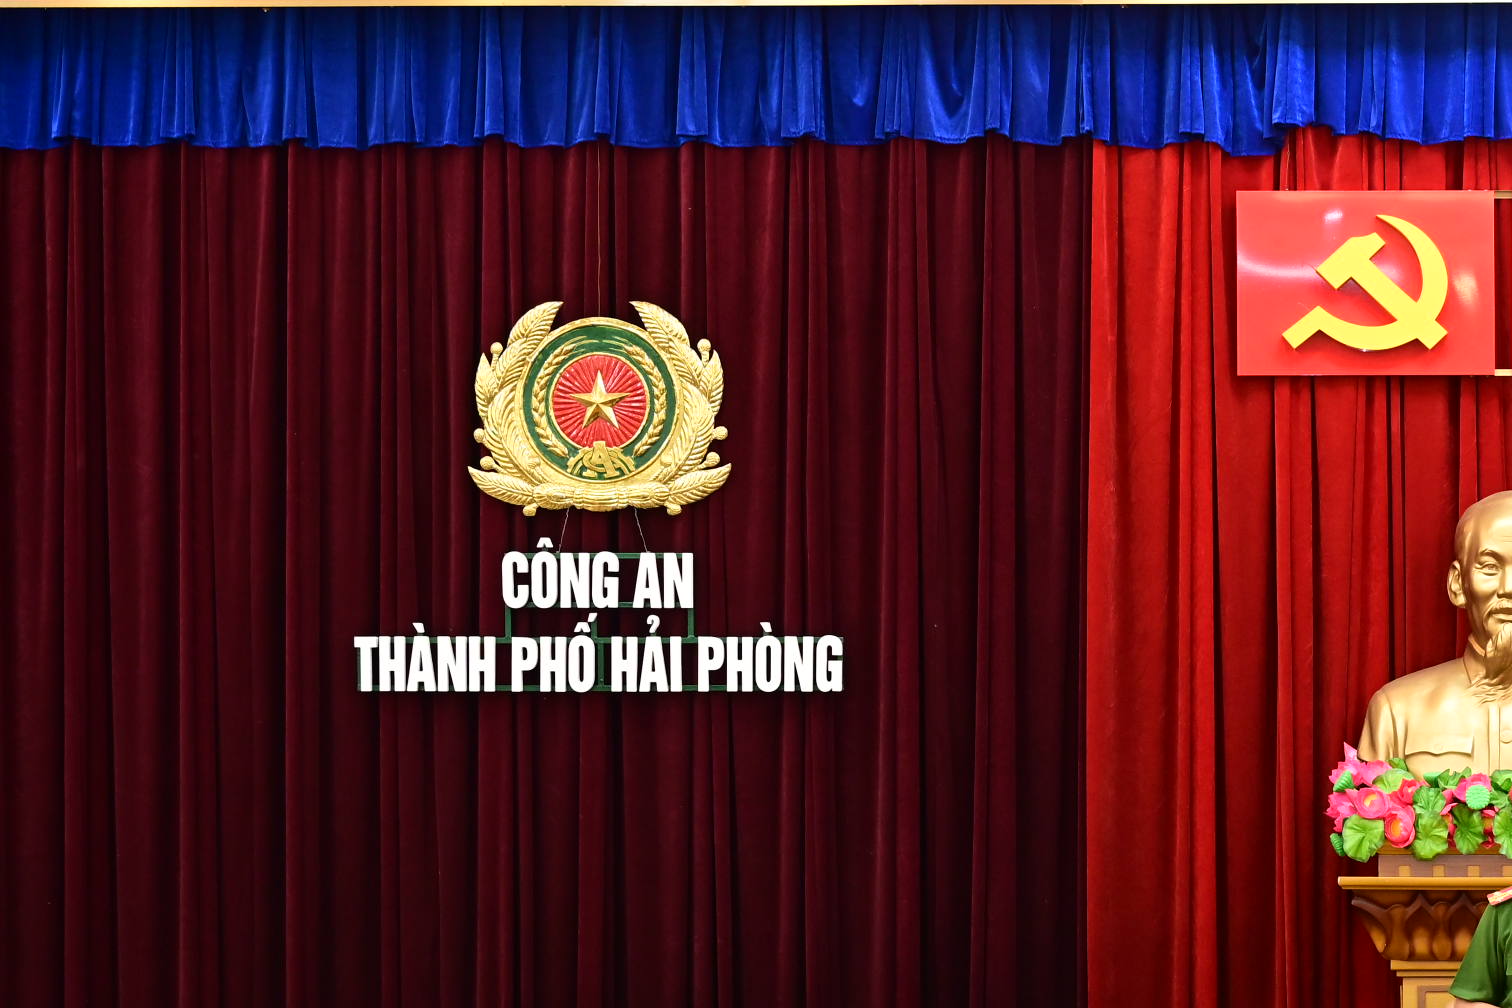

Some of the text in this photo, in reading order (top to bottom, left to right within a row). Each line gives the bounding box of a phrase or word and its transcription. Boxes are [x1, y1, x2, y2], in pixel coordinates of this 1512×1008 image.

[502, 538, 693, 609] CÔNG AN
[354, 613, 844, 693] THÀNH PHỐ HẢI PHÒNG
